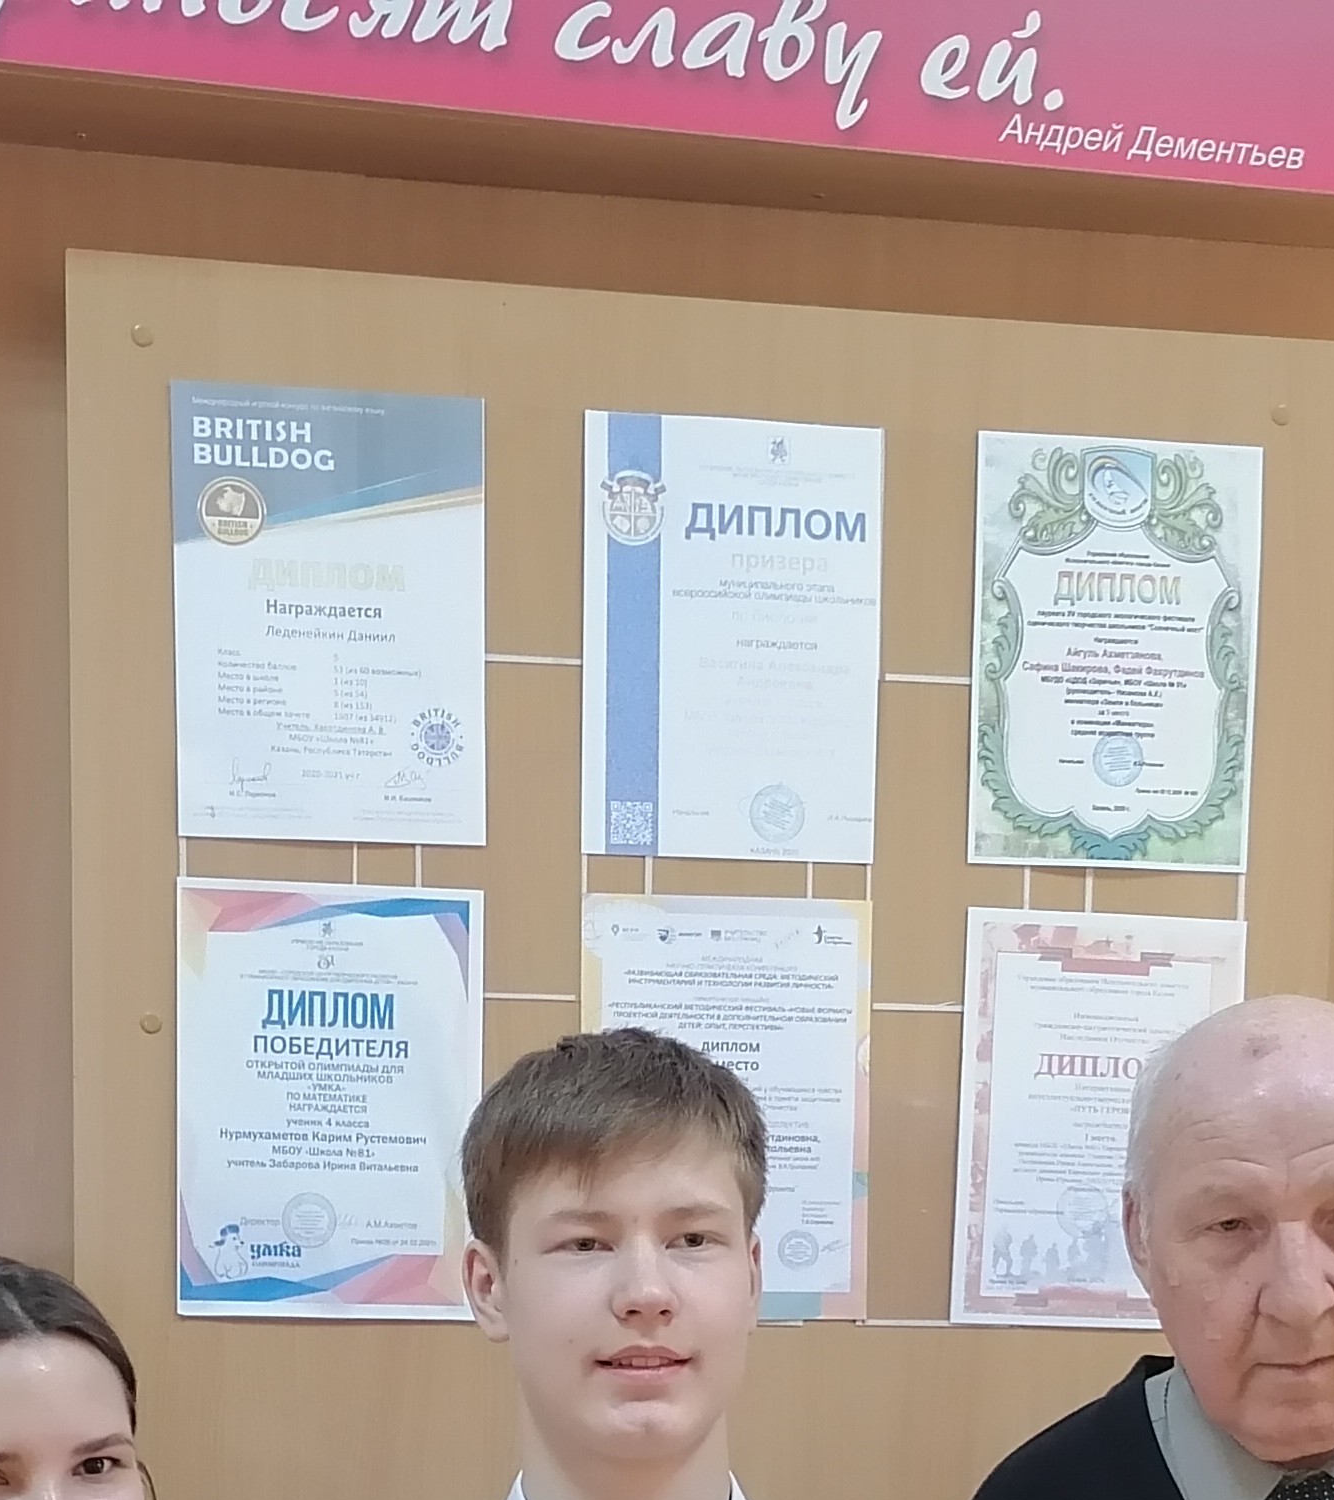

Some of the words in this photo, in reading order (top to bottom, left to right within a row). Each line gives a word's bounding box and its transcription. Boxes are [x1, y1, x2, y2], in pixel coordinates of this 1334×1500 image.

[554, 0, 882, 129] славу
[920, 10, 1065, 111] ей.
[999, 113, 1123, 154] Андрей
[1127, 125, 1305, 171] Дементьев
[192, 416, 312, 444] BRITISH
[193, 443, 335, 471] BULLDOG
[685, 502, 867, 543] ДИПЛОМ
[248, 557, 406, 592] ДИПЛОМ
[672, 588, 751, 600] всероссийской
[718, 578, 804, 594] муниципального
[1053, 570, 1182, 606] ДИПЛОМ
[266, 599, 383, 619] Награждается
[266, 625, 345, 642] Леденейкин
[347, 629, 397, 644] Даниил
[736, 637, 818, 651] награждается
[217, 671, 245, 681] Место
[217, 683, 245, 693] Место
[217, 694, 245, 704] Место
[217, 706, 245, 716] Место
[411, 707, 462, 729] BRITISH
[288, 733, 314, 744] МБОУ
[409, 742, 465, 769] BULLDOG
[261, 988, 395, 1031] ДИПЛОМ
[253, 1035, 409, 1060] ПОБЕДИТЕЛЯ
[701, 1041, 760, 1054] ДИПЛОМ
[246, 1059, 305, 1072] ОТКРЫТОЙ
[307, 1061, 379, 1075] ОЛИМПИАДЫ
[381, 1064, 404, 1075] ДЛЯ
[1033, 1052, 1144, 1081] ДИПЛО
[257, 1070, 314, 1082] МЛАДШИХ
[316, 1072, 394, 1085] ШКОЛЬНИКОВ
[307, 1082, 348, 1093] «УМКА»
[286, 1091, 302, 1102] ПО
[302, 1092, 368, 1104] МАТЕМАТИКЕ
[289, 1102, 368, 1115] НАГРАЖДАЕТСЯ
[286, 1117, 323, 1128] ученик
[325, 1117, 333, 1127] 4
[334, 1119, 370, 1129] класса
[219, 1127, 309, 1144] Нурмухаметов
[311, 1130, 353, 1145] Карим
[355, 1131, 427, 1147] Рустемович
[271, 1144, 303, 1156] МБОУ
[304, 1146, 343, 1158] «Школа
[345, 1148, 376, 1159] №81»
[226, 1158, 267, 1170] учитель
[268, 1158, 321, 1172] Забарова
[322, 1160, 357, 1172] Ирина
[358, 1161, 420, 1174] Витальевна
[240, 1215, 281, 1228] Директор
